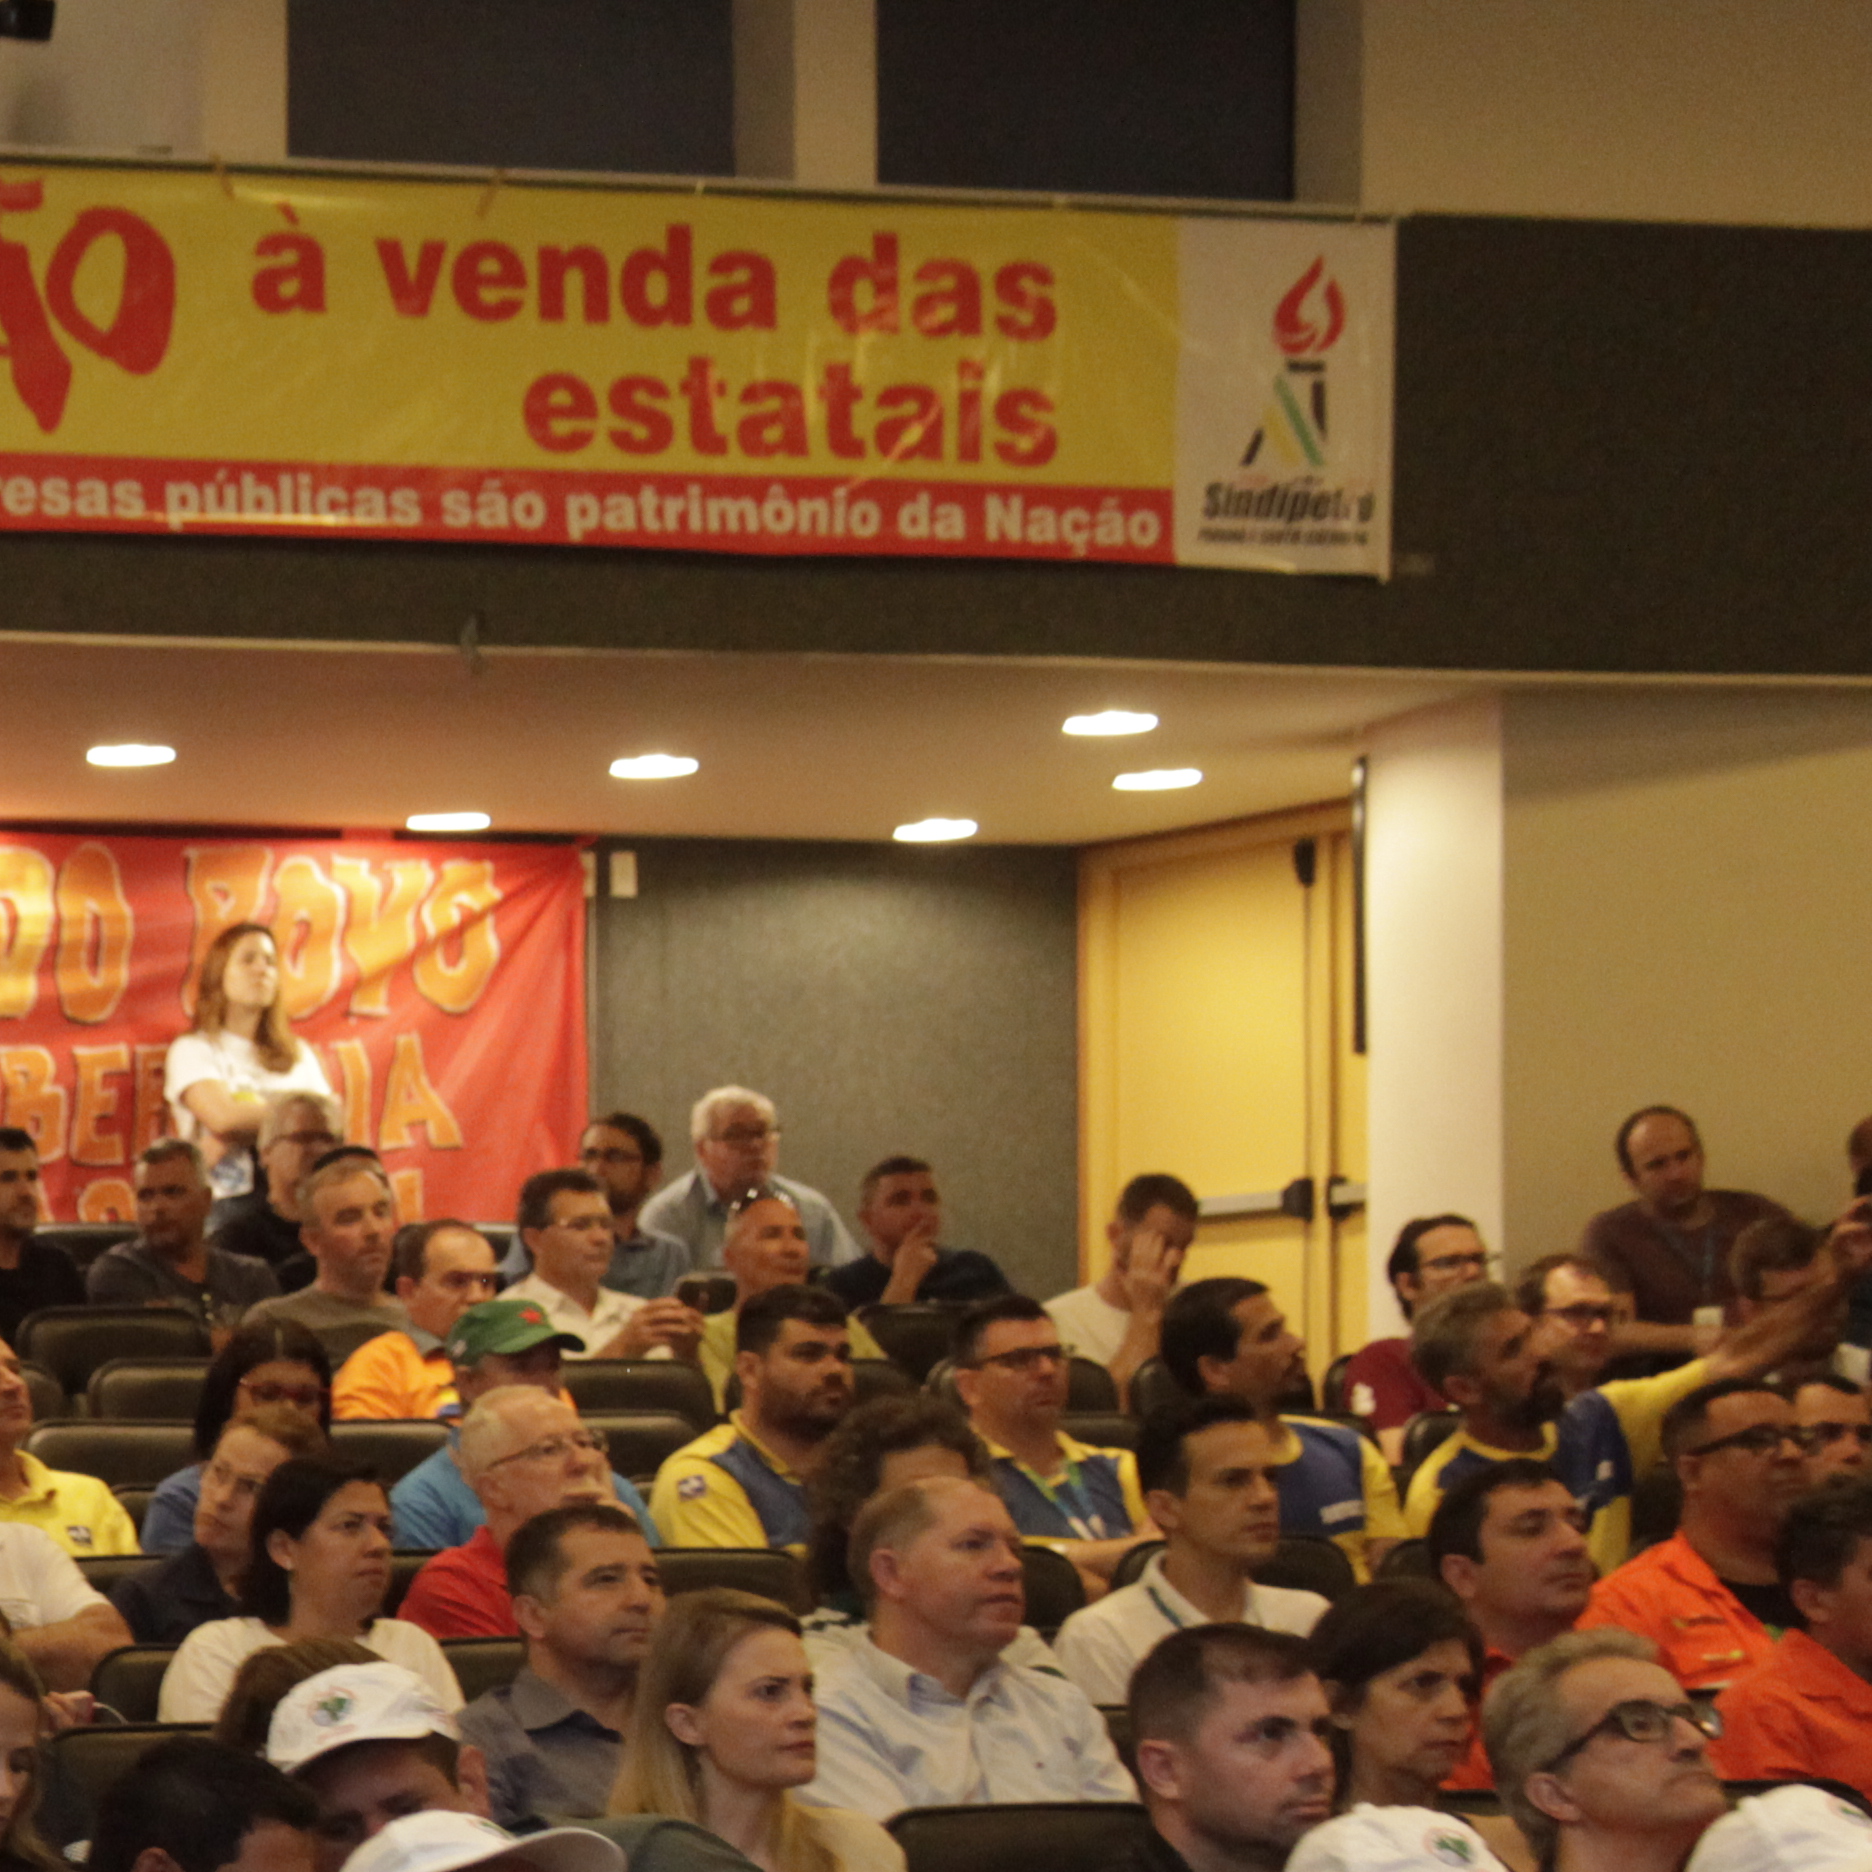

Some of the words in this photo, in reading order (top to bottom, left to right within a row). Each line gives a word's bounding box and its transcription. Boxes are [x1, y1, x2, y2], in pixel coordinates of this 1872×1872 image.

[250, 201, 327, 314] à
[375, 224, 778, 332] venda
[828, 231, 1057, 342] das
[522, 356, 1059, 468] estatais
[167, 469, 421, 531] públicas
[442, 480, 546, 531] são
[565, 486, 880, 541] patrimônio
[898, 493, 966, 543] da
[985, 494, 1161, 557] Nação
